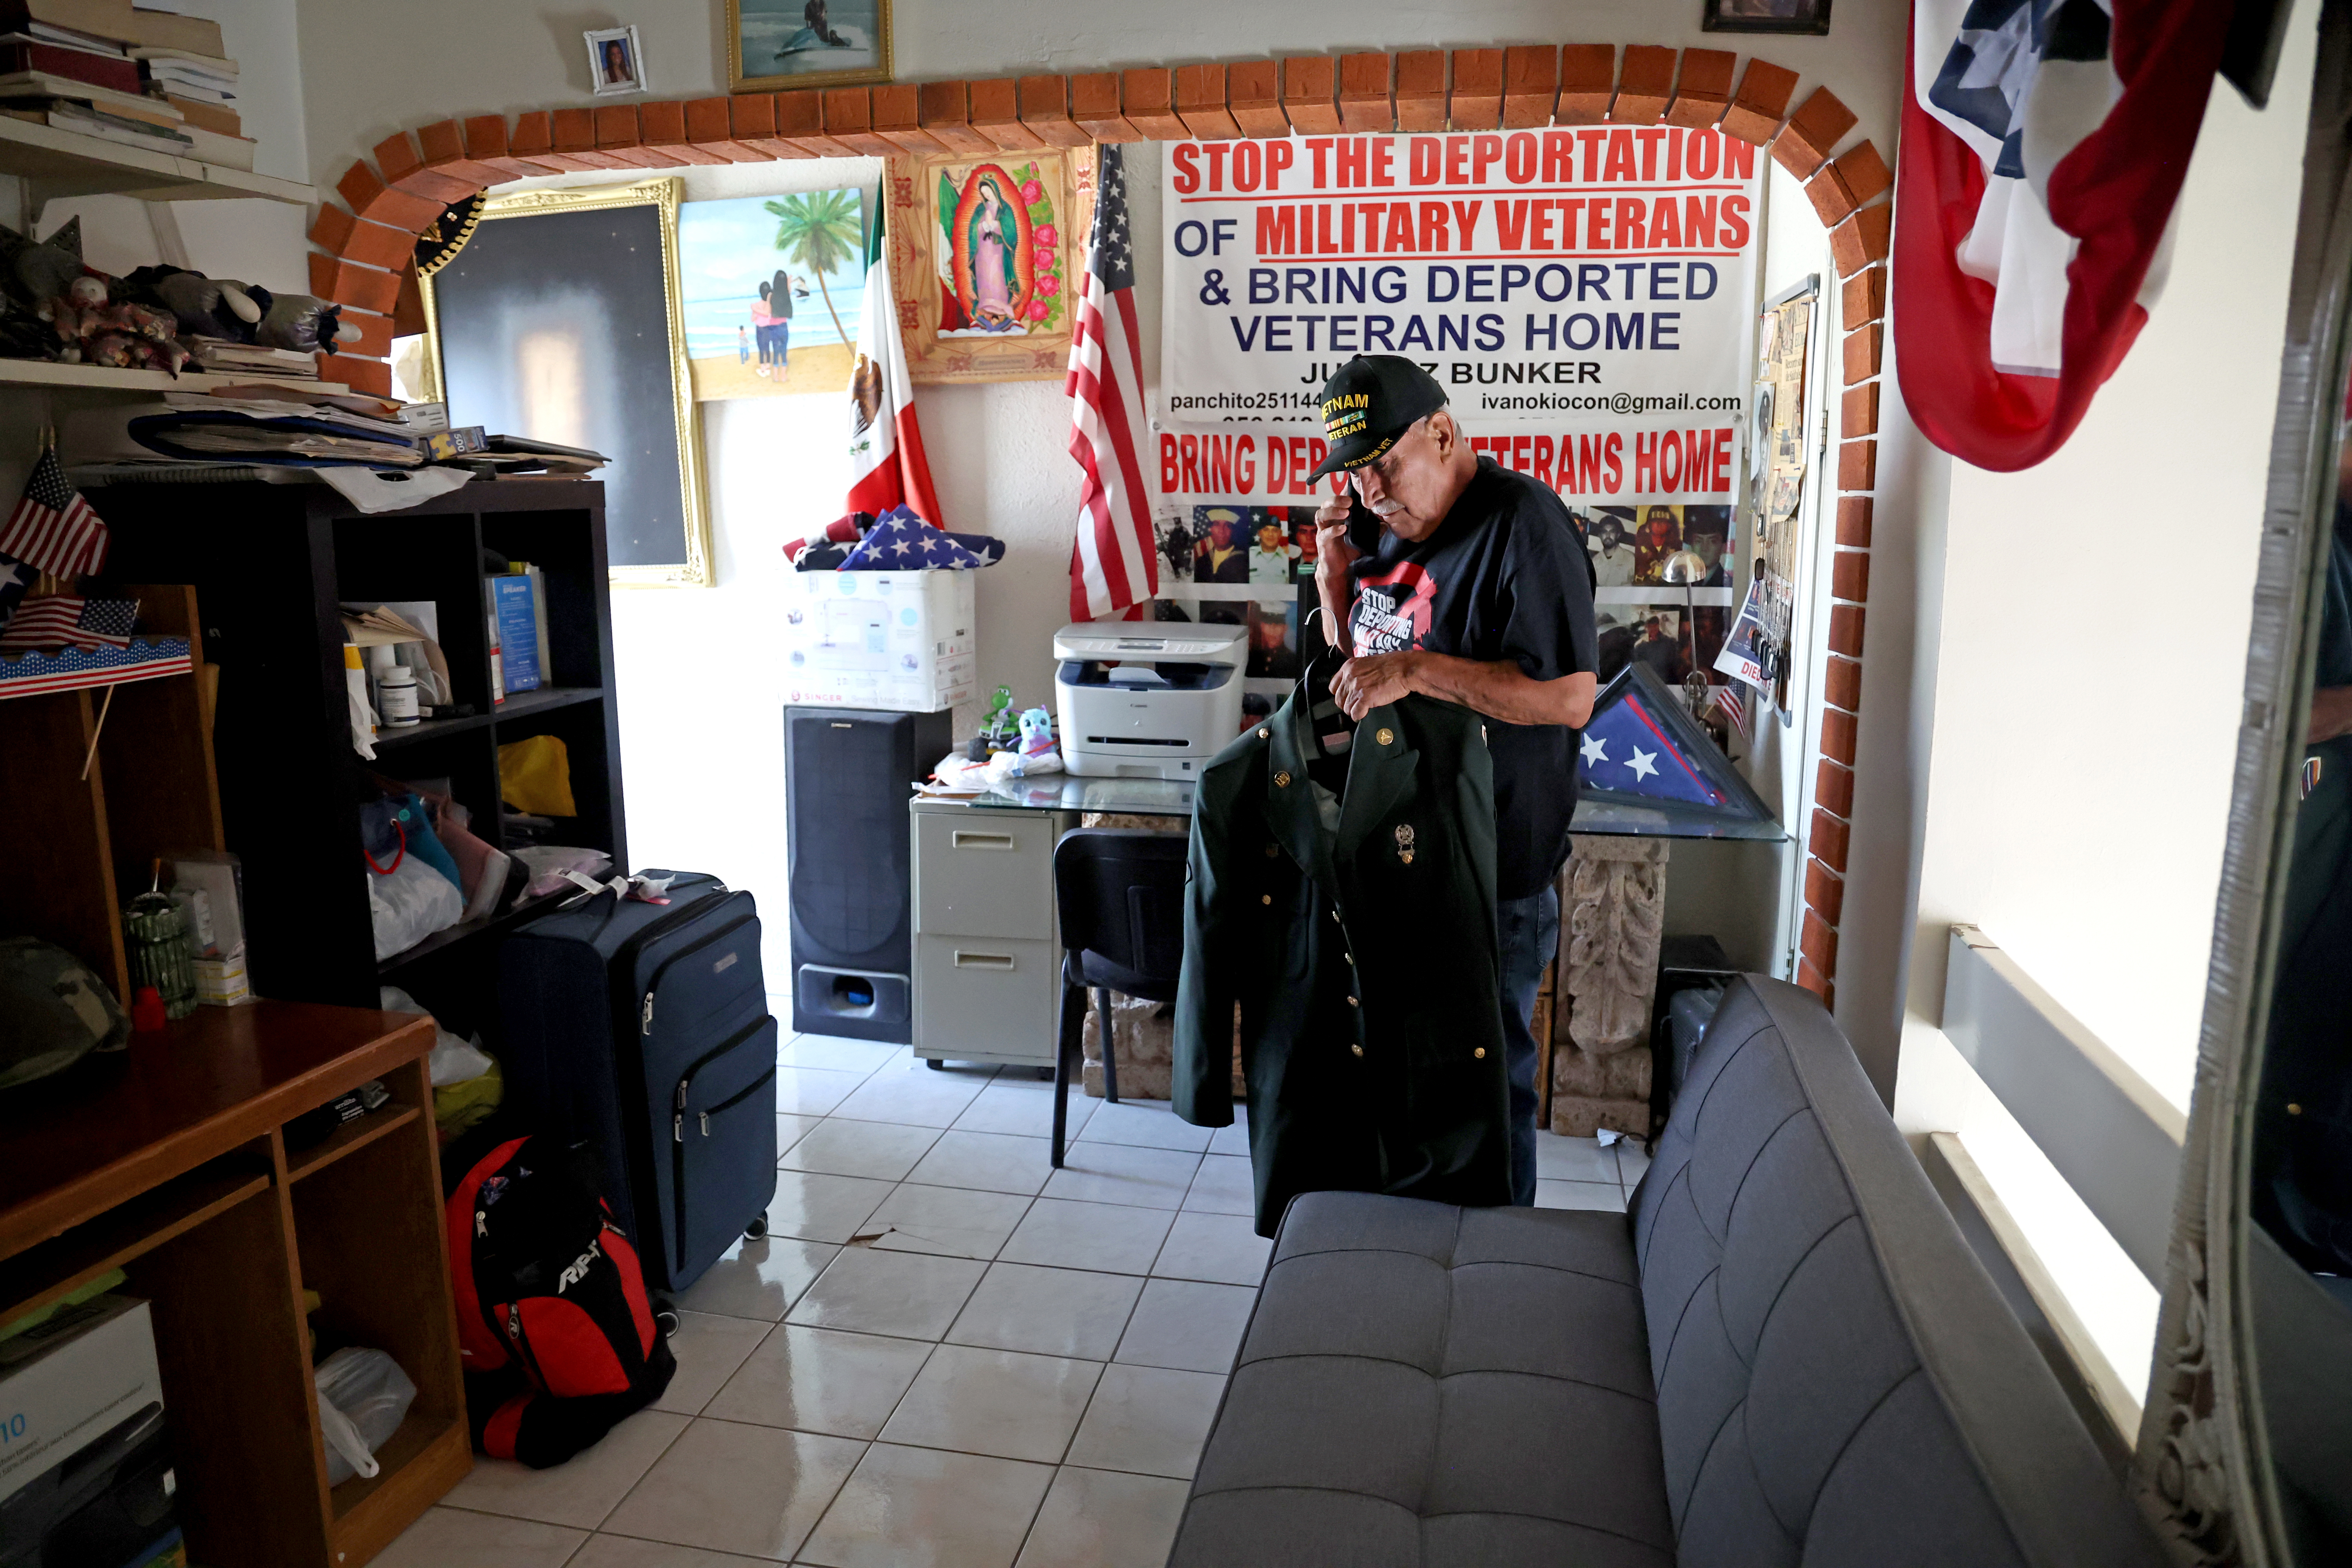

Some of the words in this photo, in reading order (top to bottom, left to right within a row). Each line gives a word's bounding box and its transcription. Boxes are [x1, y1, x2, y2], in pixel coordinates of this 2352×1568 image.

[1172, 140, 1293, 194] STOP
[1305, 137, 1395, 189] THE
[1409, 128, 1755, 185] DEPORTATION
[1174, 219, 1238, 257] OF
[1255, 200, 1483, 255] MILITARY
[1494, 195, 1750, 251] VETERANS
[1200, 268, 1231, 305] &
[1249, 266, 1406, 304] BRING
[1427, 262, 1718, 303] DEPORTED
[1230, 313, 1505, 352] VETERANS
[1525, 312, 1681, 351] HOME
[1301, 363, 1439, 384] JUZ
[1451, 362, 1602, 384] BUNKER
[1482, 392, 1741, 414] ivanokiocon@gmail.com
[453, 433, 466, 452] 500
[1344, 450, 1381, 468] VIETNAM
[1378, 437, 1394, 450] VET
[1160, 433, 1256, 495] BRING
[1635, 428, 1733, 494] HOME
[1362, 588, 1396, 614] STOP
[1354, 622, 1402, 652] MILITARY
[1358, 604, 1412, 640] DEPORTING
[804, 693, 842, 702] SINGER
[851, 695, 878, 705] Sewing
[879, 696, 901, 704] Made
